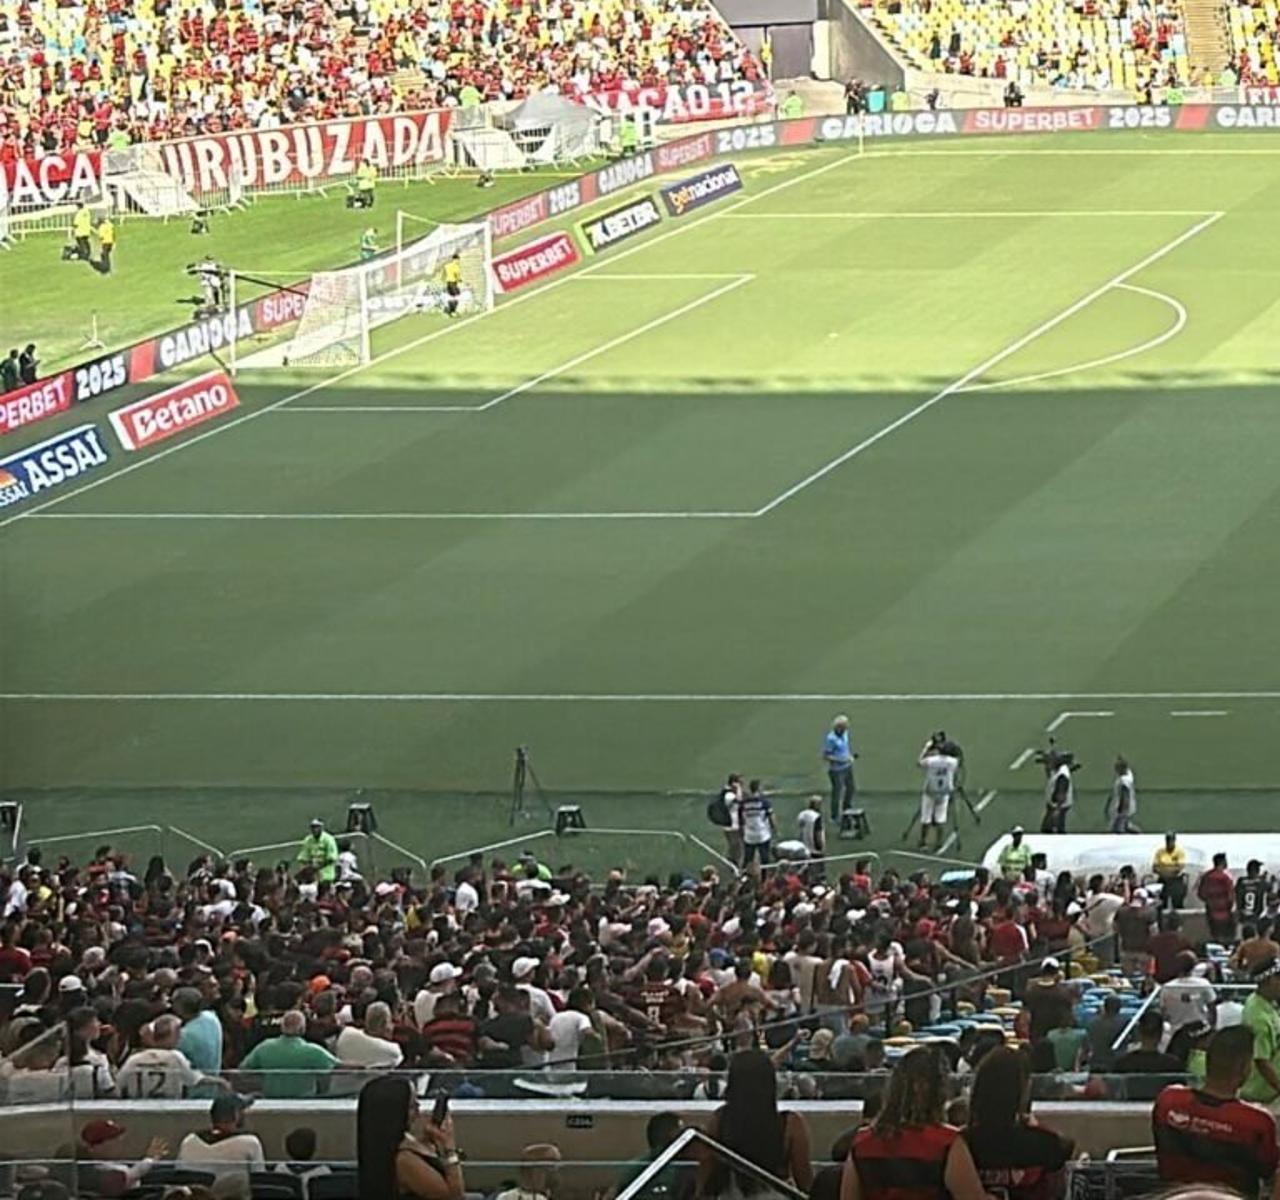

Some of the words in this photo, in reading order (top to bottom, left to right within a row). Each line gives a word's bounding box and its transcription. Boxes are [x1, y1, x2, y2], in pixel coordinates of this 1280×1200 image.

[718, 79, 754, 113] 12
[718, 125, 776, 152] 2025
[822, 111, 957, 139] CARIOCA
[974, 107, 1095, 132] SUPERBET
[1108, 105, 1171, 129] 2025
[166, 112, 446, 192] URUBUZADA
[550, 182, 580, 216] 2025
[668, 166, 739, 216] betnacional
[497, 241, 572, 283] SUPERBET
[160, 310, 252, 368] CARIOCA
[77, 356, 127, 401] 2025
[132, 383, 229, 441] Betano
[1245, 891, 1256, 910] 9
[136, 1071, 166, 1099] 12
